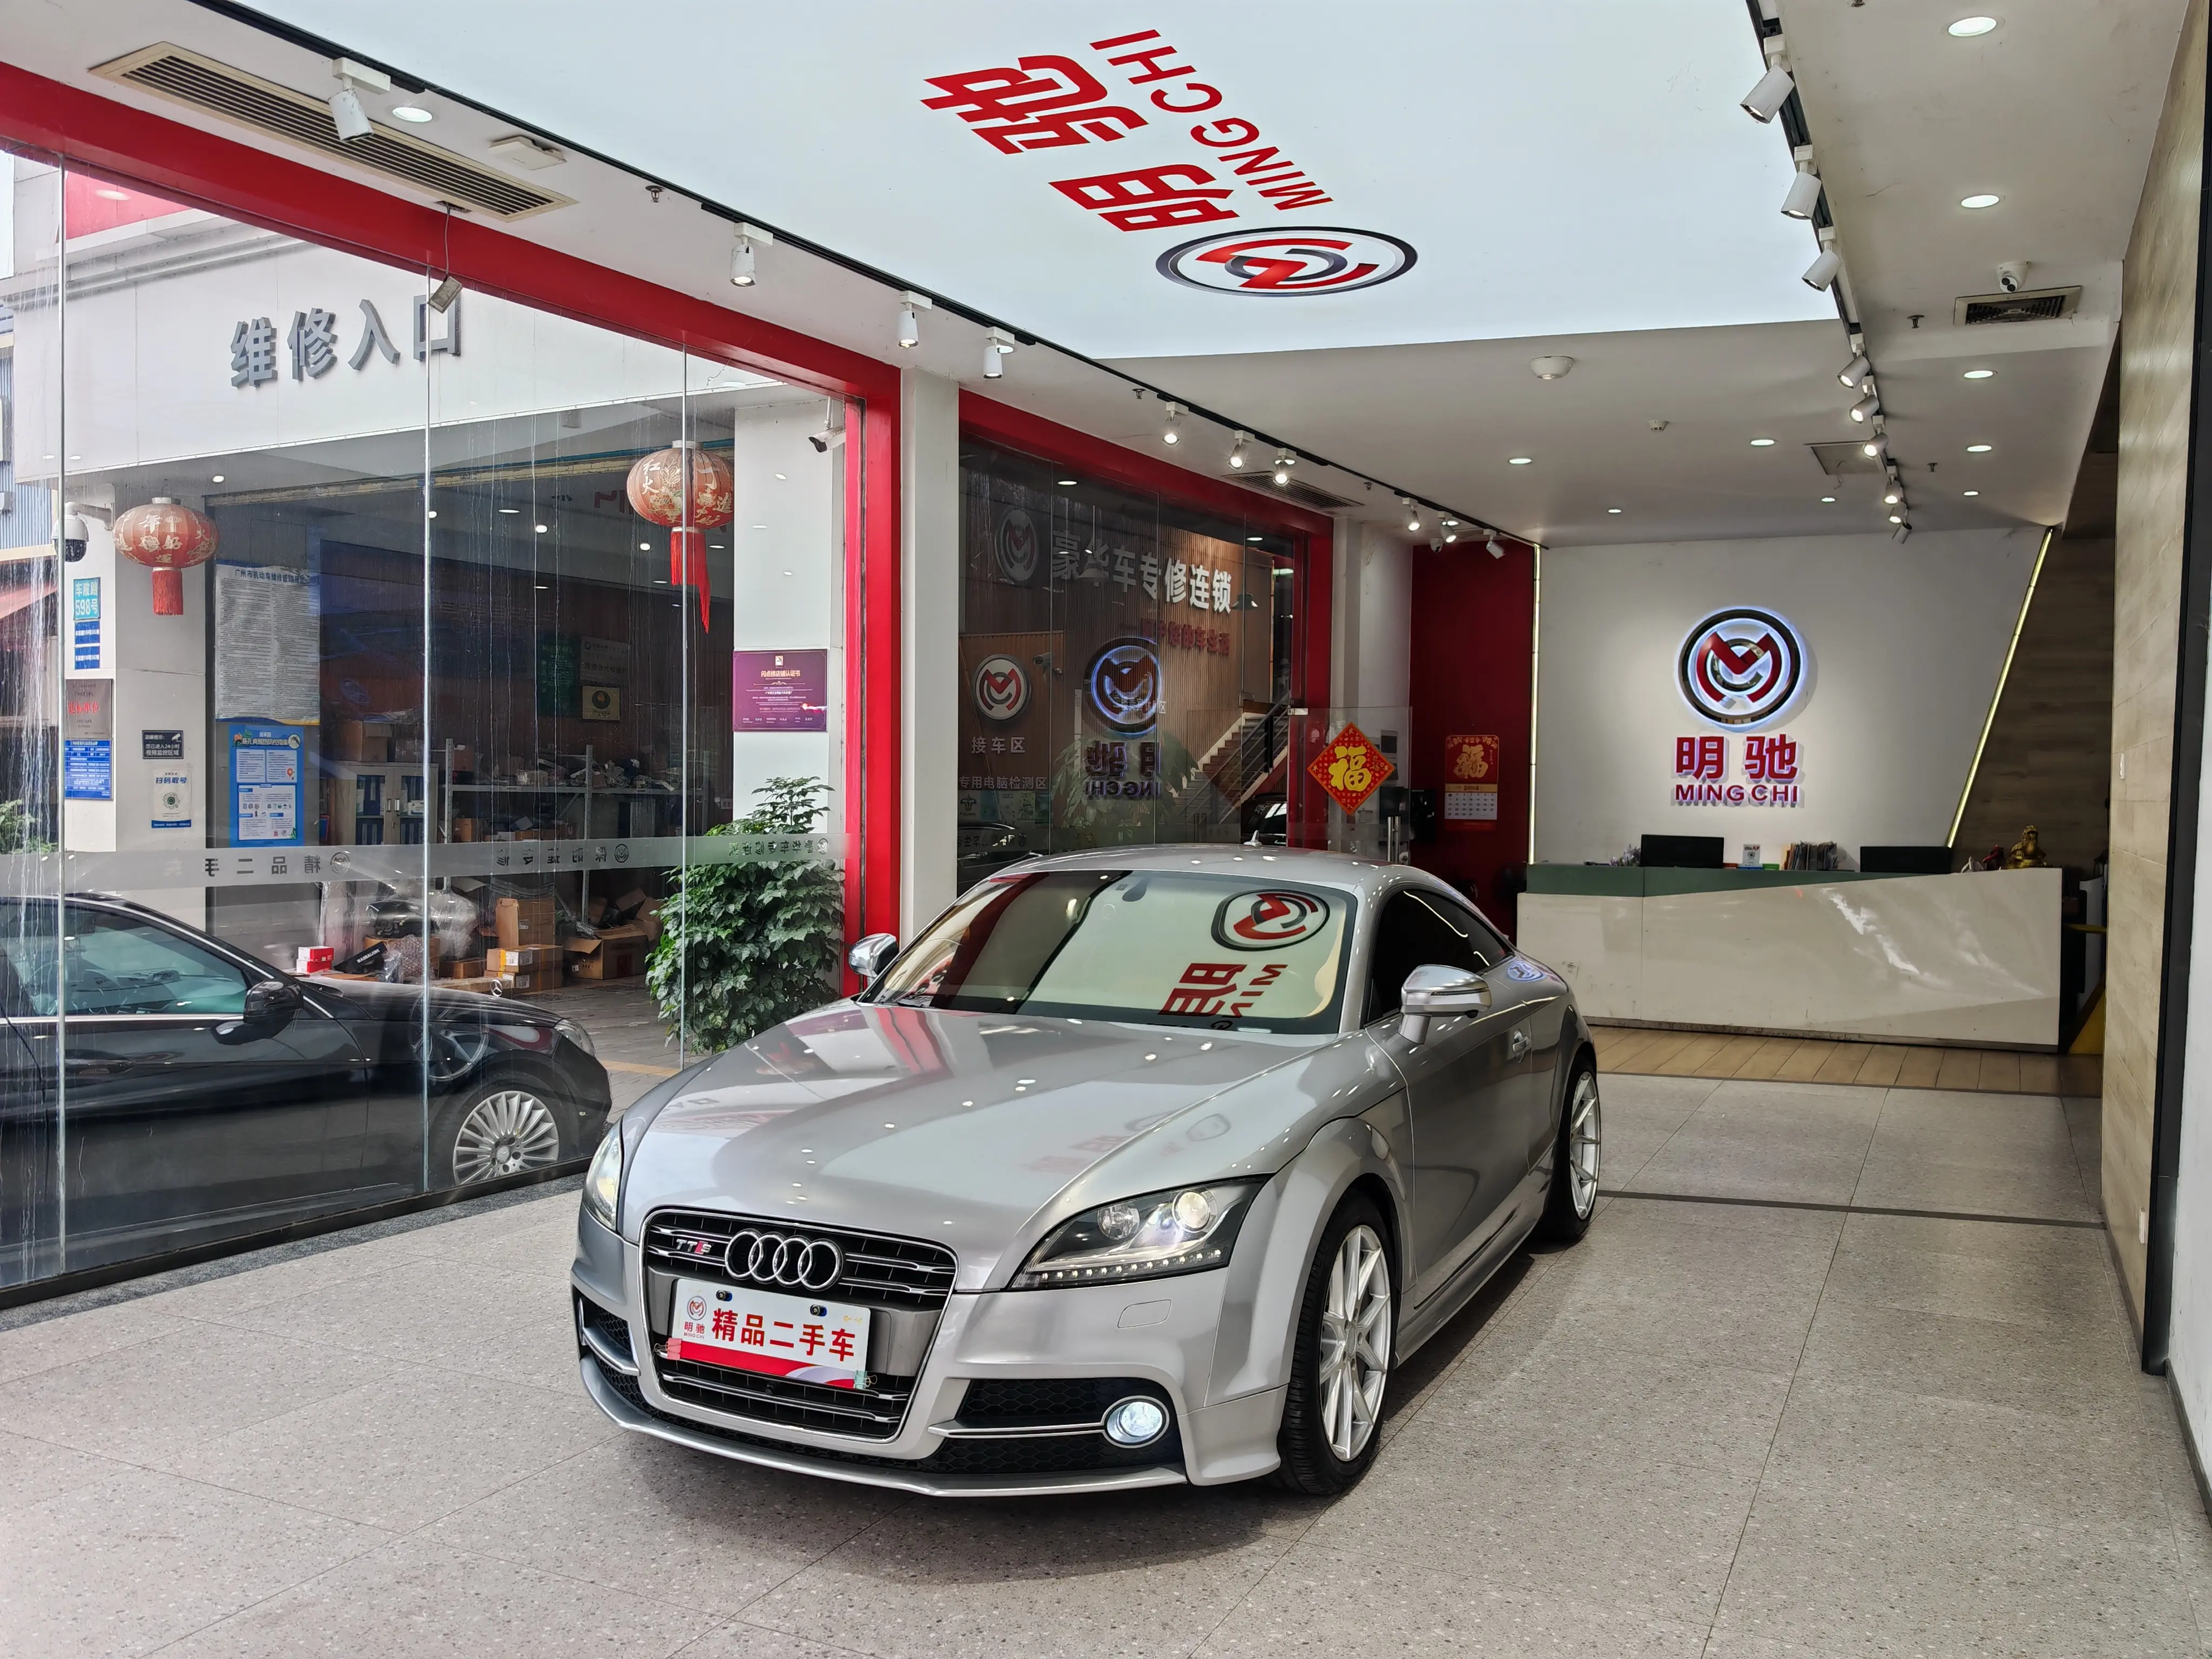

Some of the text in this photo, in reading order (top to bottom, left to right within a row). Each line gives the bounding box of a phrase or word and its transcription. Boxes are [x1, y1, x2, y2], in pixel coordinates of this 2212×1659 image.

[920, 55, 1240, 232] 明驰
[231, 293, 463, 389] 维修入口
[1052, 530, 1232, 614] 豪华车专修连锁
[75, 598, 98, 616] 598号
[971, 737, 1026, 754] 接车区
[1328, 745, 1372, 792] 福
[1676, 733, 1798, 780] 明驰
[959, 775, 1047, 790] 专用电脑检测区
[676, 1239, 712, 1254] TTS
[684, 1321, 705, 1334] 明驰
[711, 1307, 855, 1362] 精品二手车
